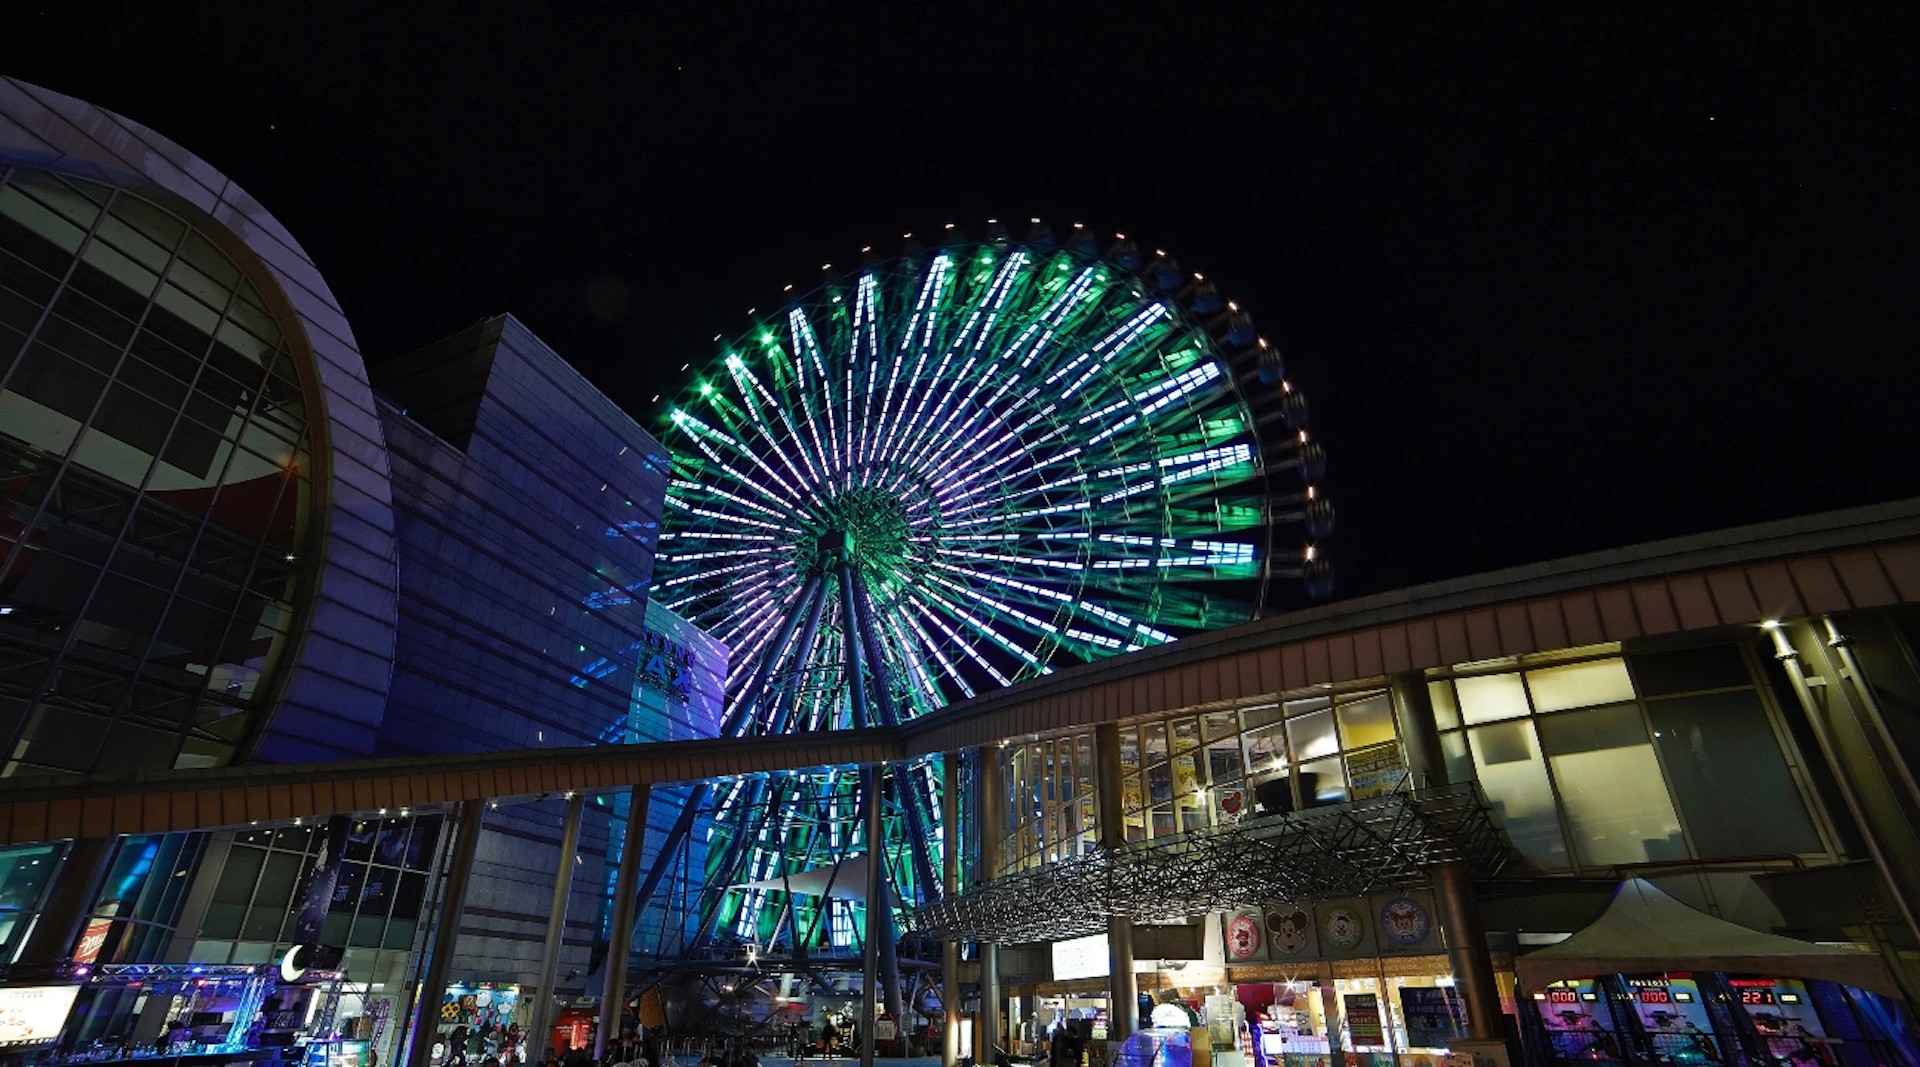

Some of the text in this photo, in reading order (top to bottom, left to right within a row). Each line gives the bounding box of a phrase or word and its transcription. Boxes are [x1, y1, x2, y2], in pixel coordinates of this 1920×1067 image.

[637, 650, 692, 694] AX
[1551, 991, 1576, 1003] 000
[1641, 991, 1668, 1003] 000
[1742, 991, 1772, 1004] 221
